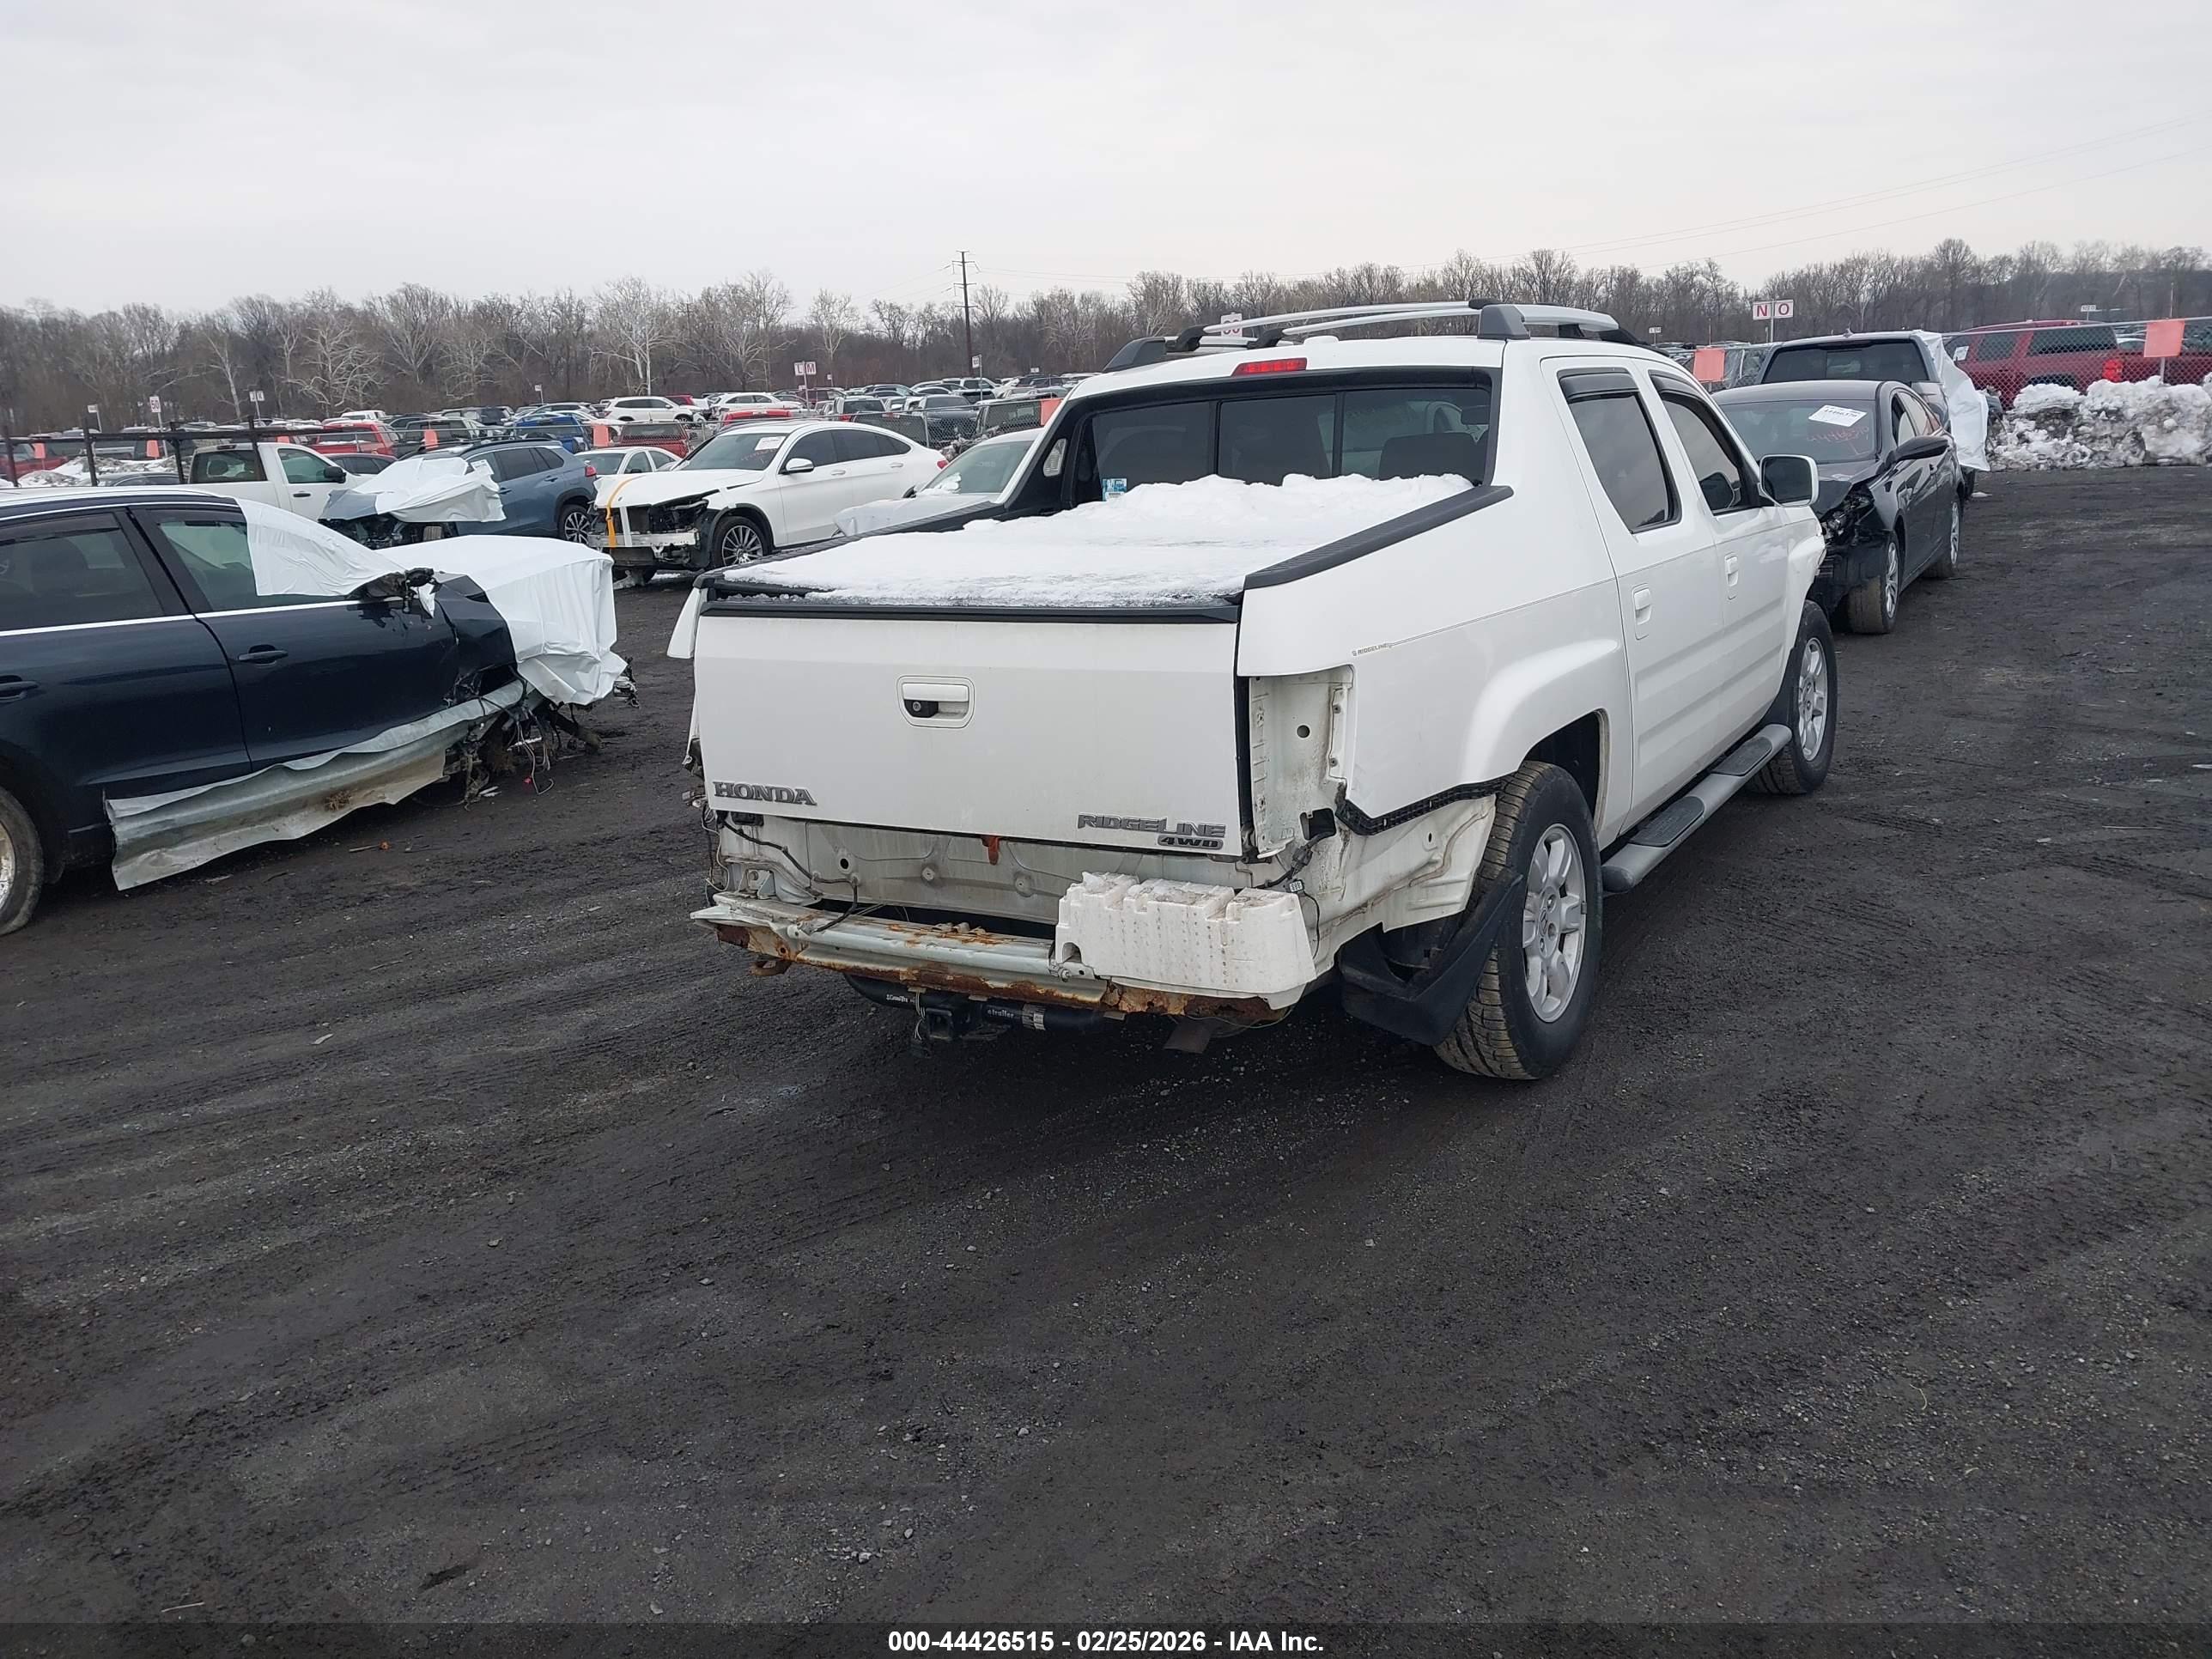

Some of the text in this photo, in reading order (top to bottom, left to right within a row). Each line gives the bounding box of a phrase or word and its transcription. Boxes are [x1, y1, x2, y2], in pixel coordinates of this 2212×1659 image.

[1756, 302, 1790, 317] N O
[712, 780, 817, 806] HONDA
[1077, 813, 1226, 839] RIDGELINE
[1160, 836, 1218, 848] 4WD
